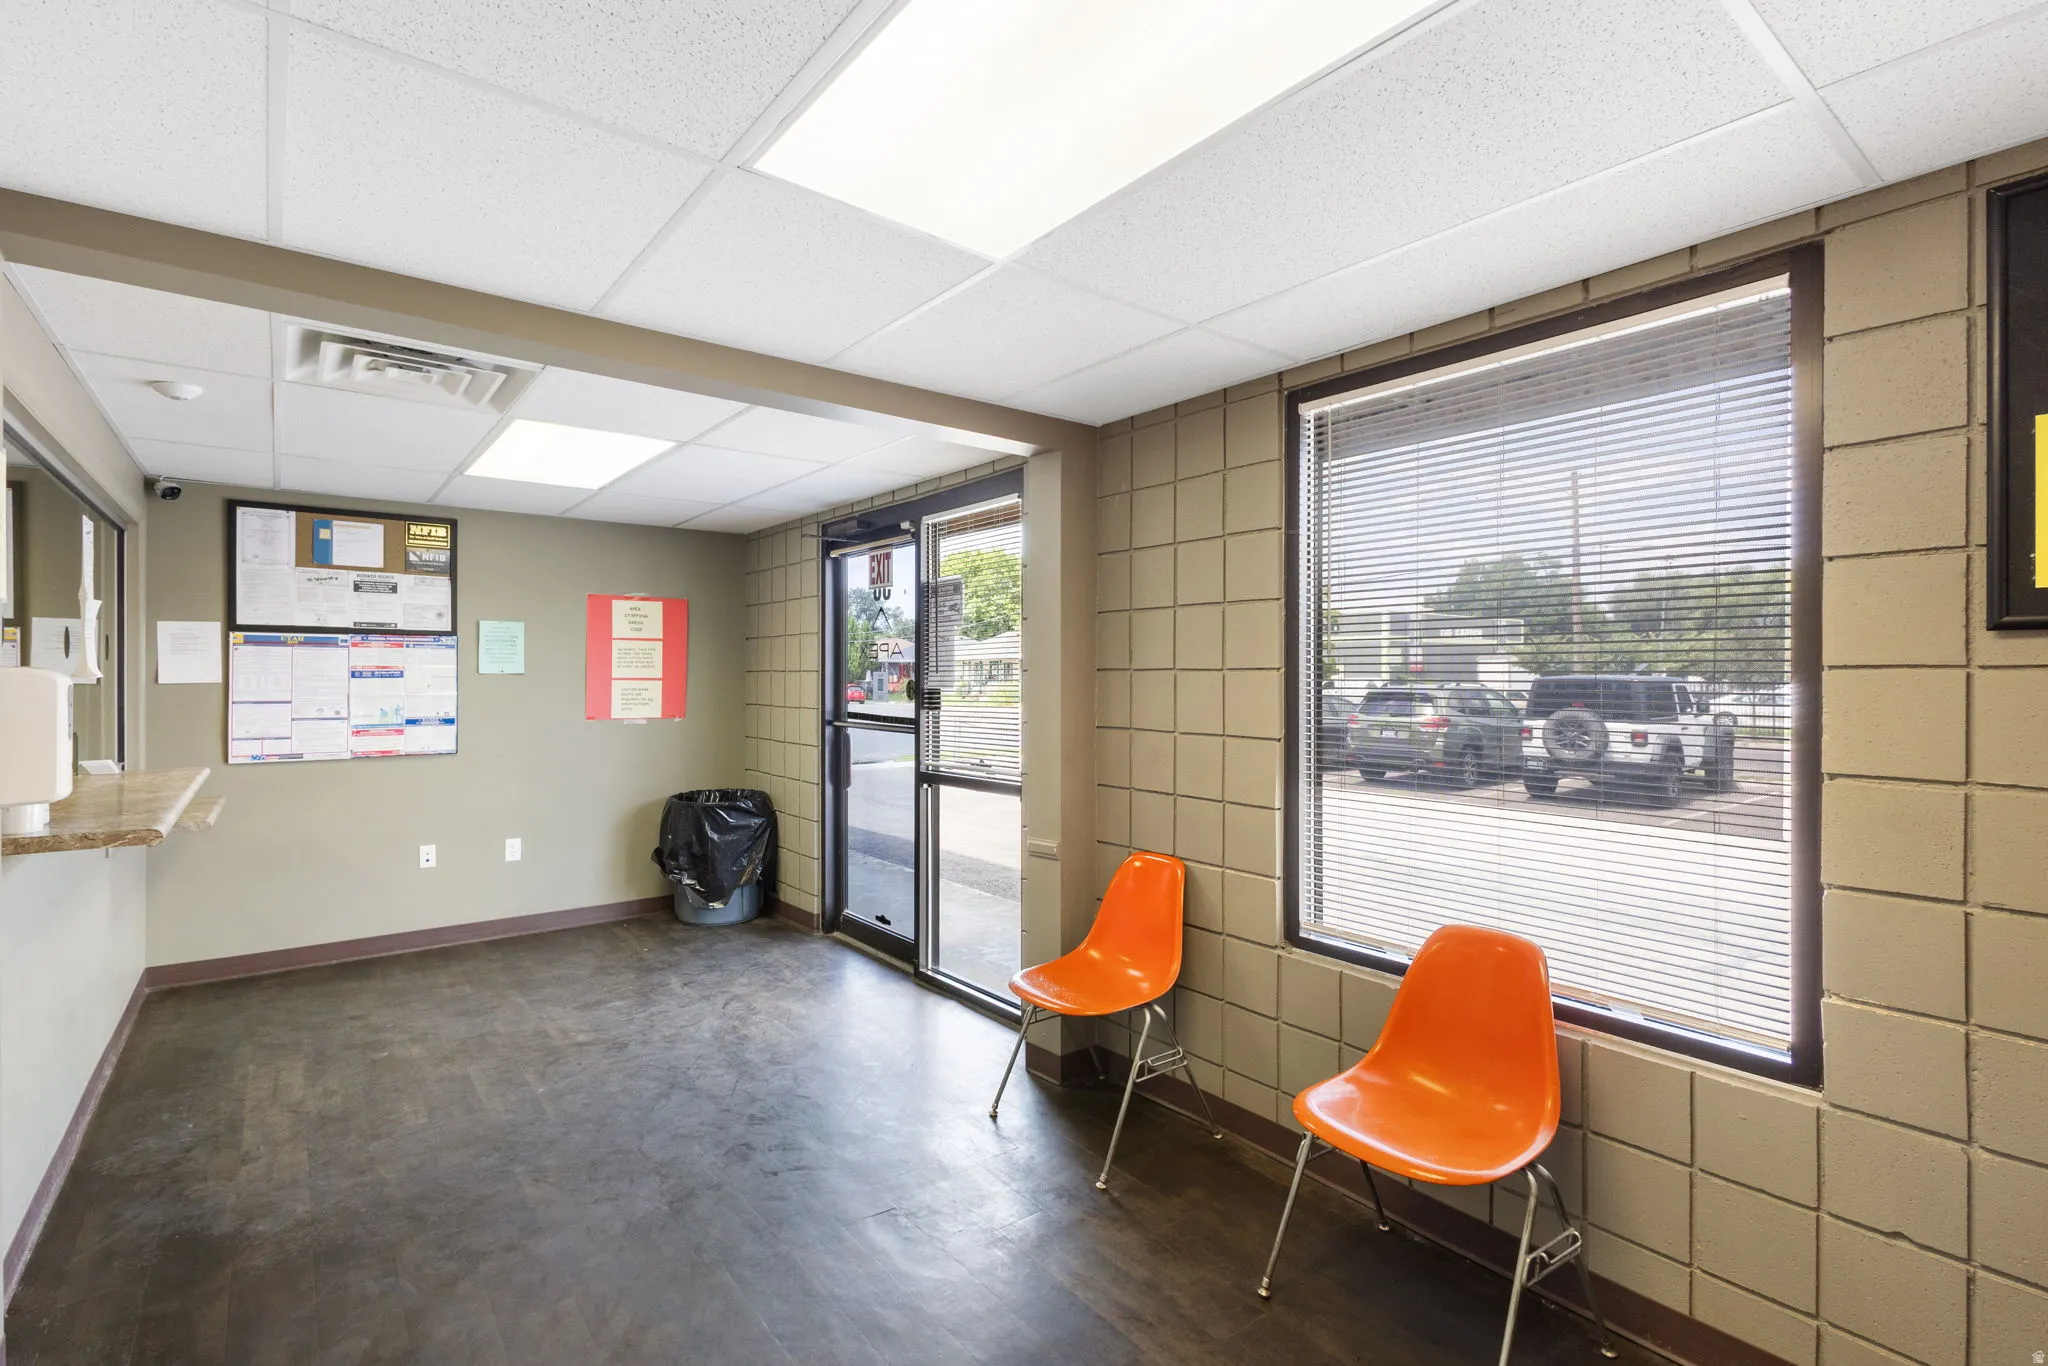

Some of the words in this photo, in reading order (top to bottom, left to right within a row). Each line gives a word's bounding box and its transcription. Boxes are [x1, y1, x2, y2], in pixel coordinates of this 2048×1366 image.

[409, 524, 447, 537] NFIB
[422, 552, 446, 562] NFIB
[870, 552, 892, 585] EXIT
